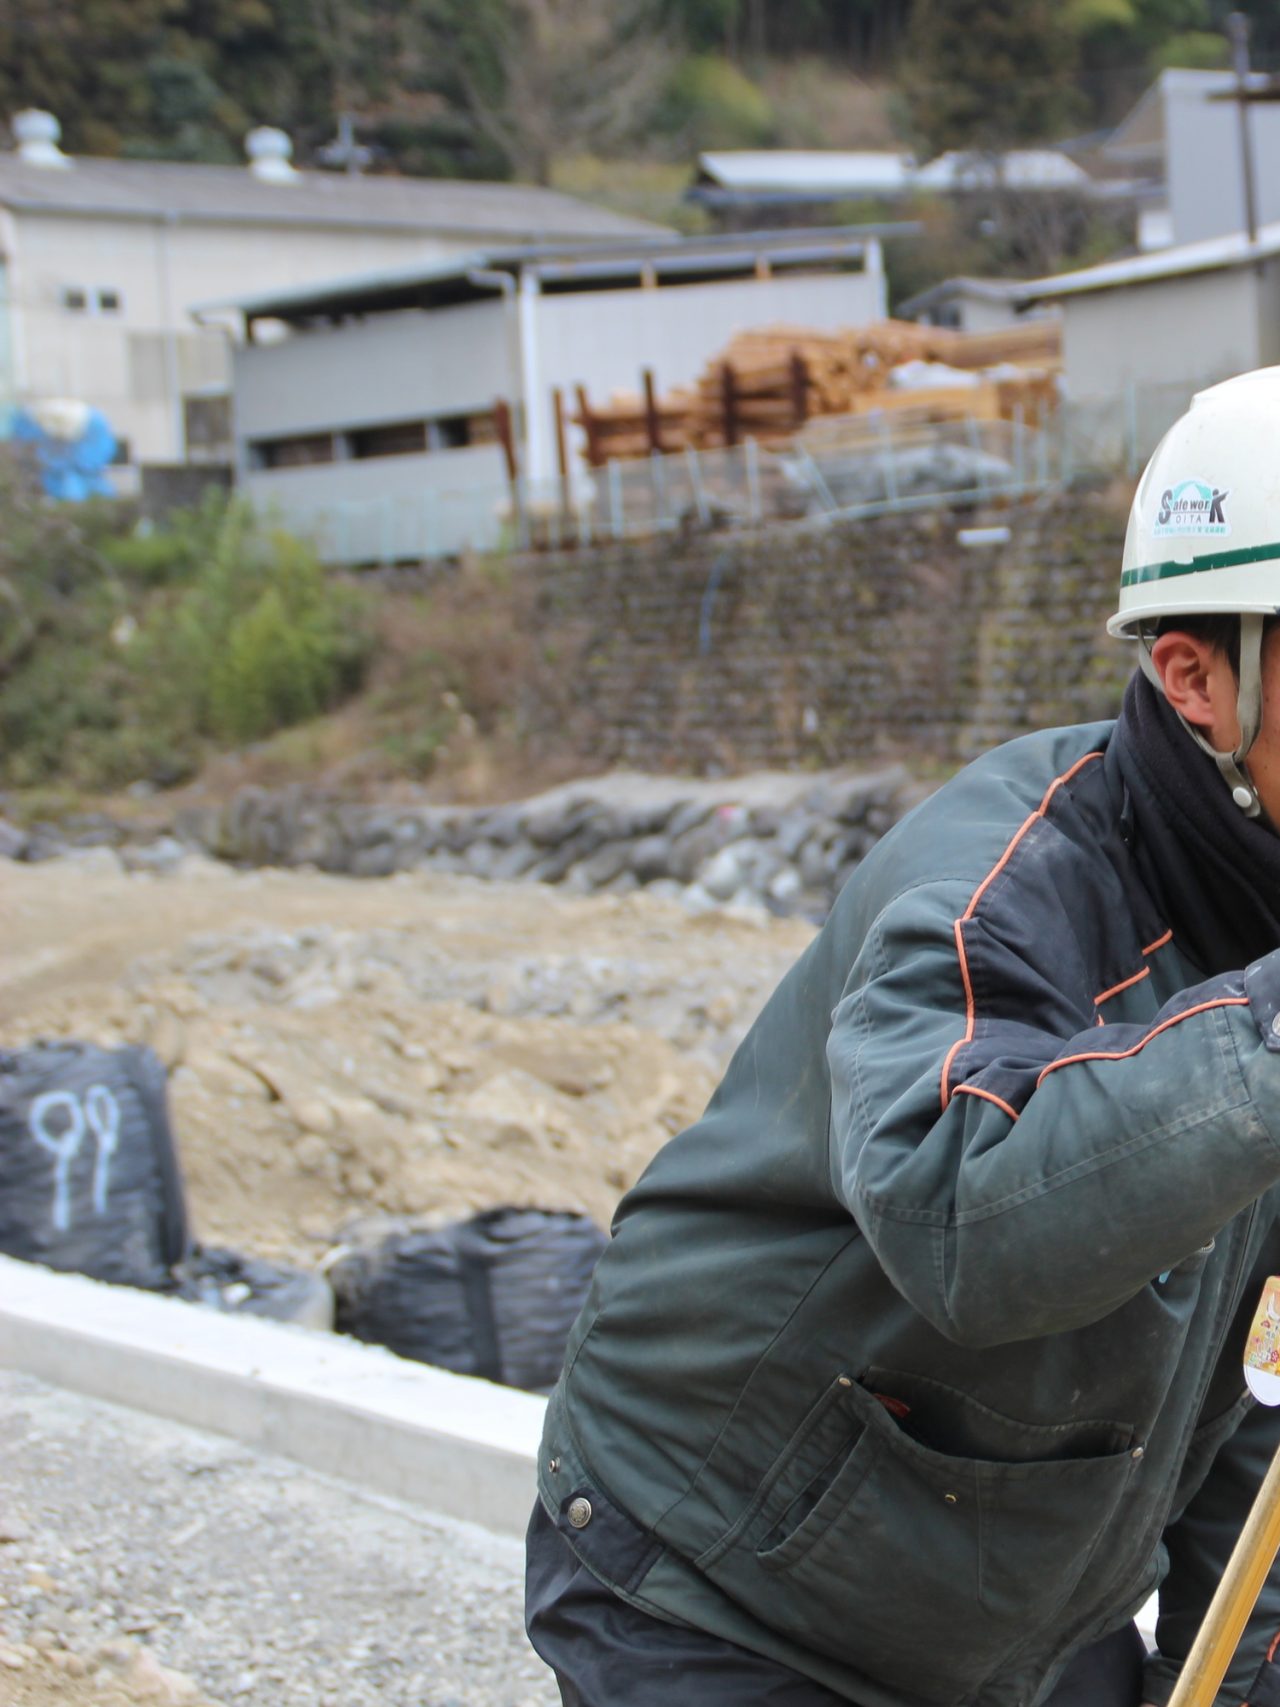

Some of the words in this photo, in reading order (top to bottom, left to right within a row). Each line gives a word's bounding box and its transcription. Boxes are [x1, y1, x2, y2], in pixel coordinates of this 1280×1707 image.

[1159, 489, 1189, 525] Safe
[1176, 514, 1202, 524] OITA
[29, 1083, 120, 1232] 99
